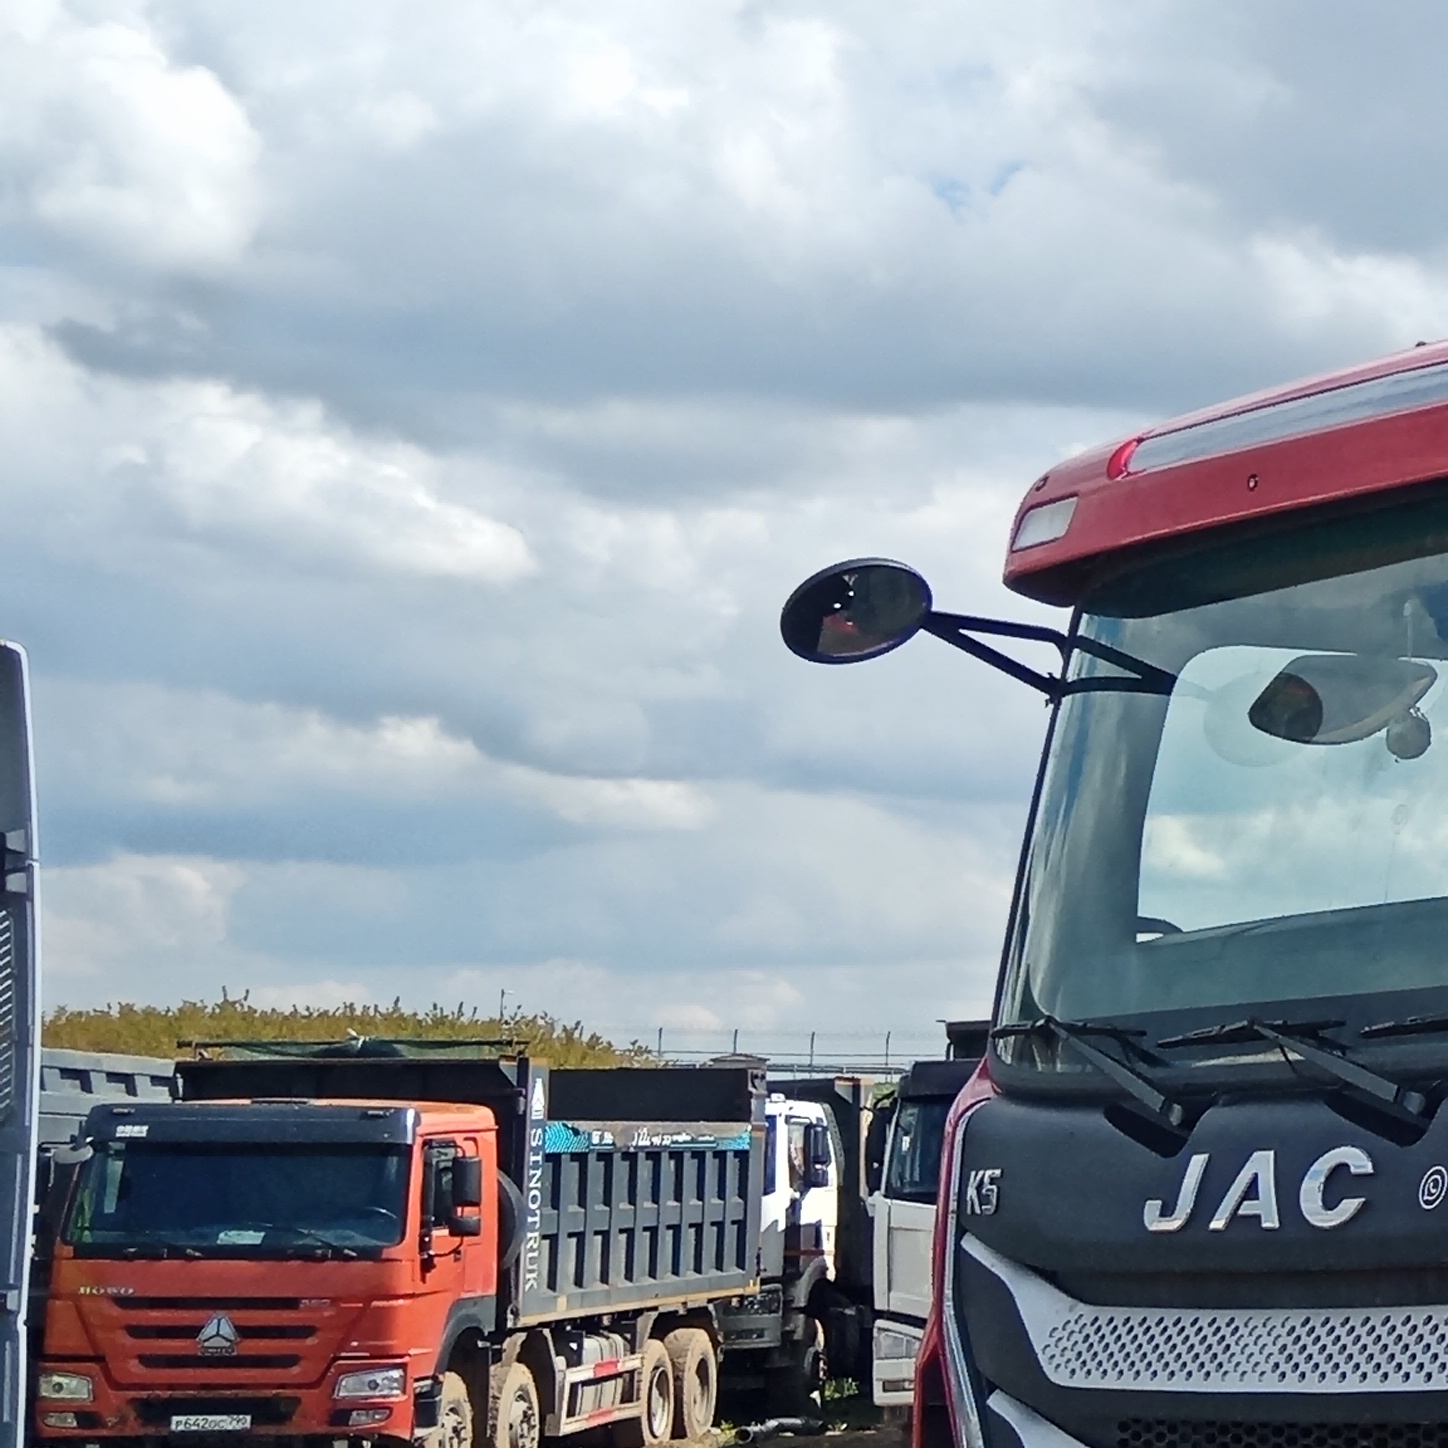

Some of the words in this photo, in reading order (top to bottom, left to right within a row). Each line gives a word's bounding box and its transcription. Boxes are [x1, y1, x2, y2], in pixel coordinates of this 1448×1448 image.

[524, 1129, 543, 1293] SINOTRUK
[965, 1169, 1003, 1216] K5
[1143, 1146, 1374, 1233] JAC
